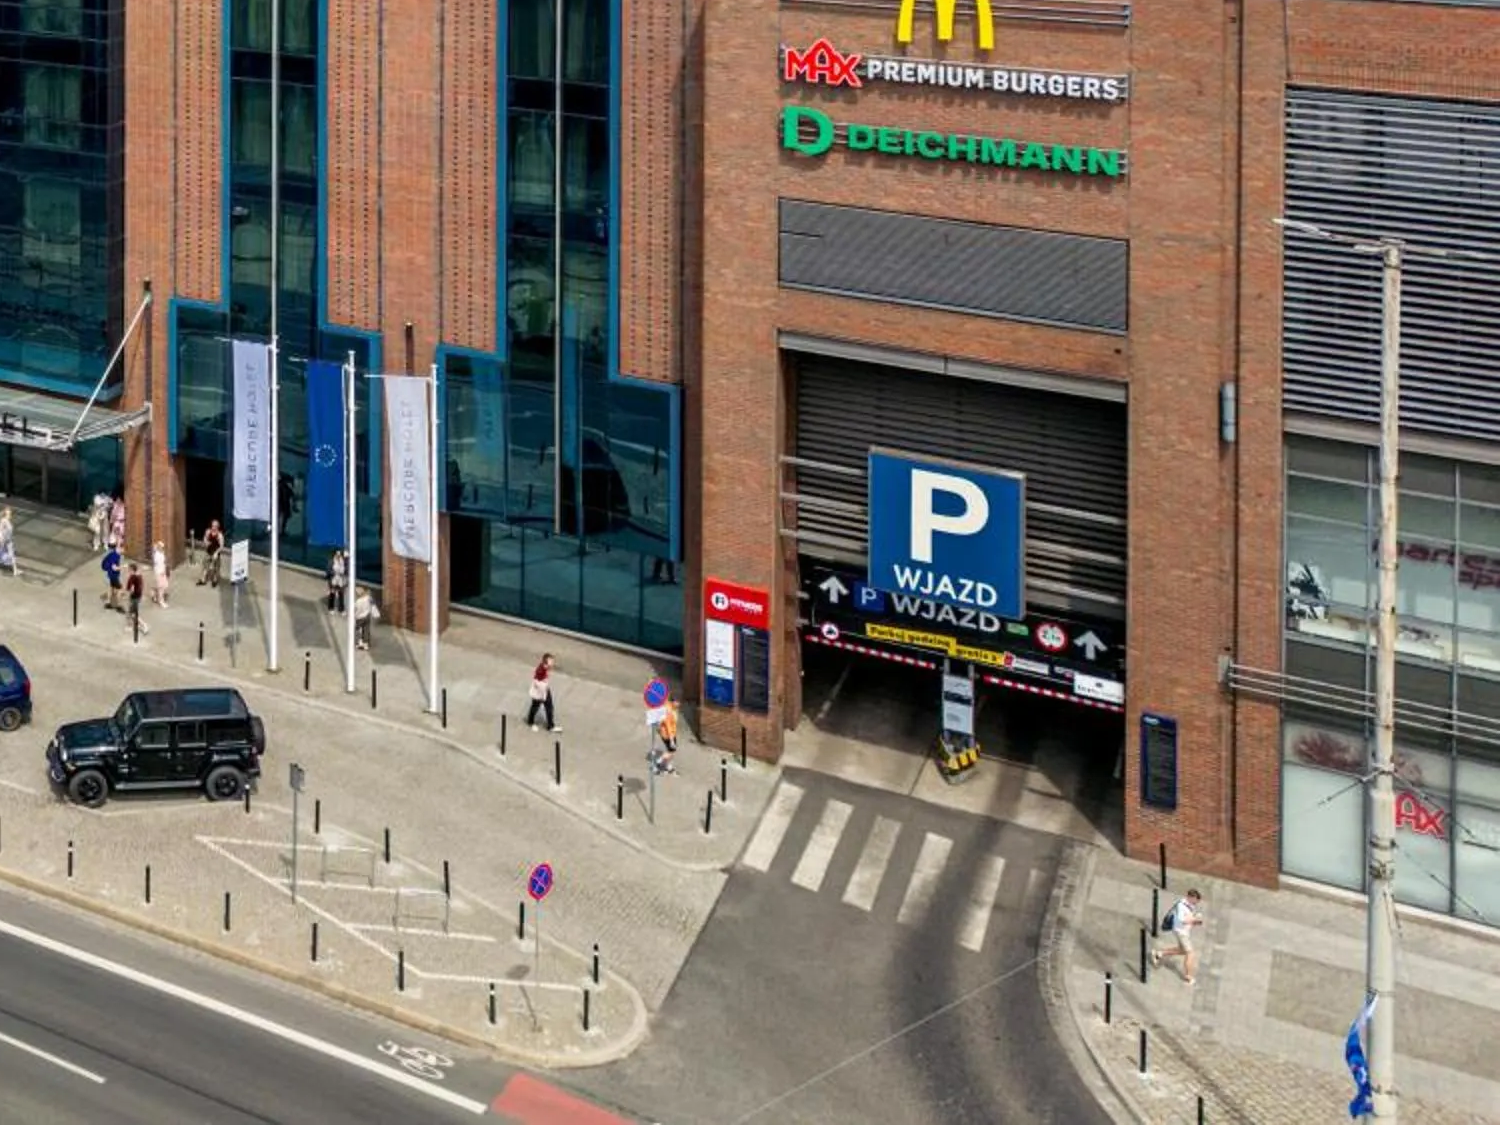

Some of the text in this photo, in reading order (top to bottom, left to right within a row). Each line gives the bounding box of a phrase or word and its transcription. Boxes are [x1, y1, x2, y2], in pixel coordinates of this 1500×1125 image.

[784, 37, 1120, 101] MAX PREMIUM BURGERS
[781, 104, 1122, 176] D DEICHMANN
[911, 468, 989, 564] P
[861, 587, 877, 605] P
[891, 592, 1001, 633] WJAZD
[893, 563, 998, 608] WJAZD
[1394, 789, 1446, 840] AX
